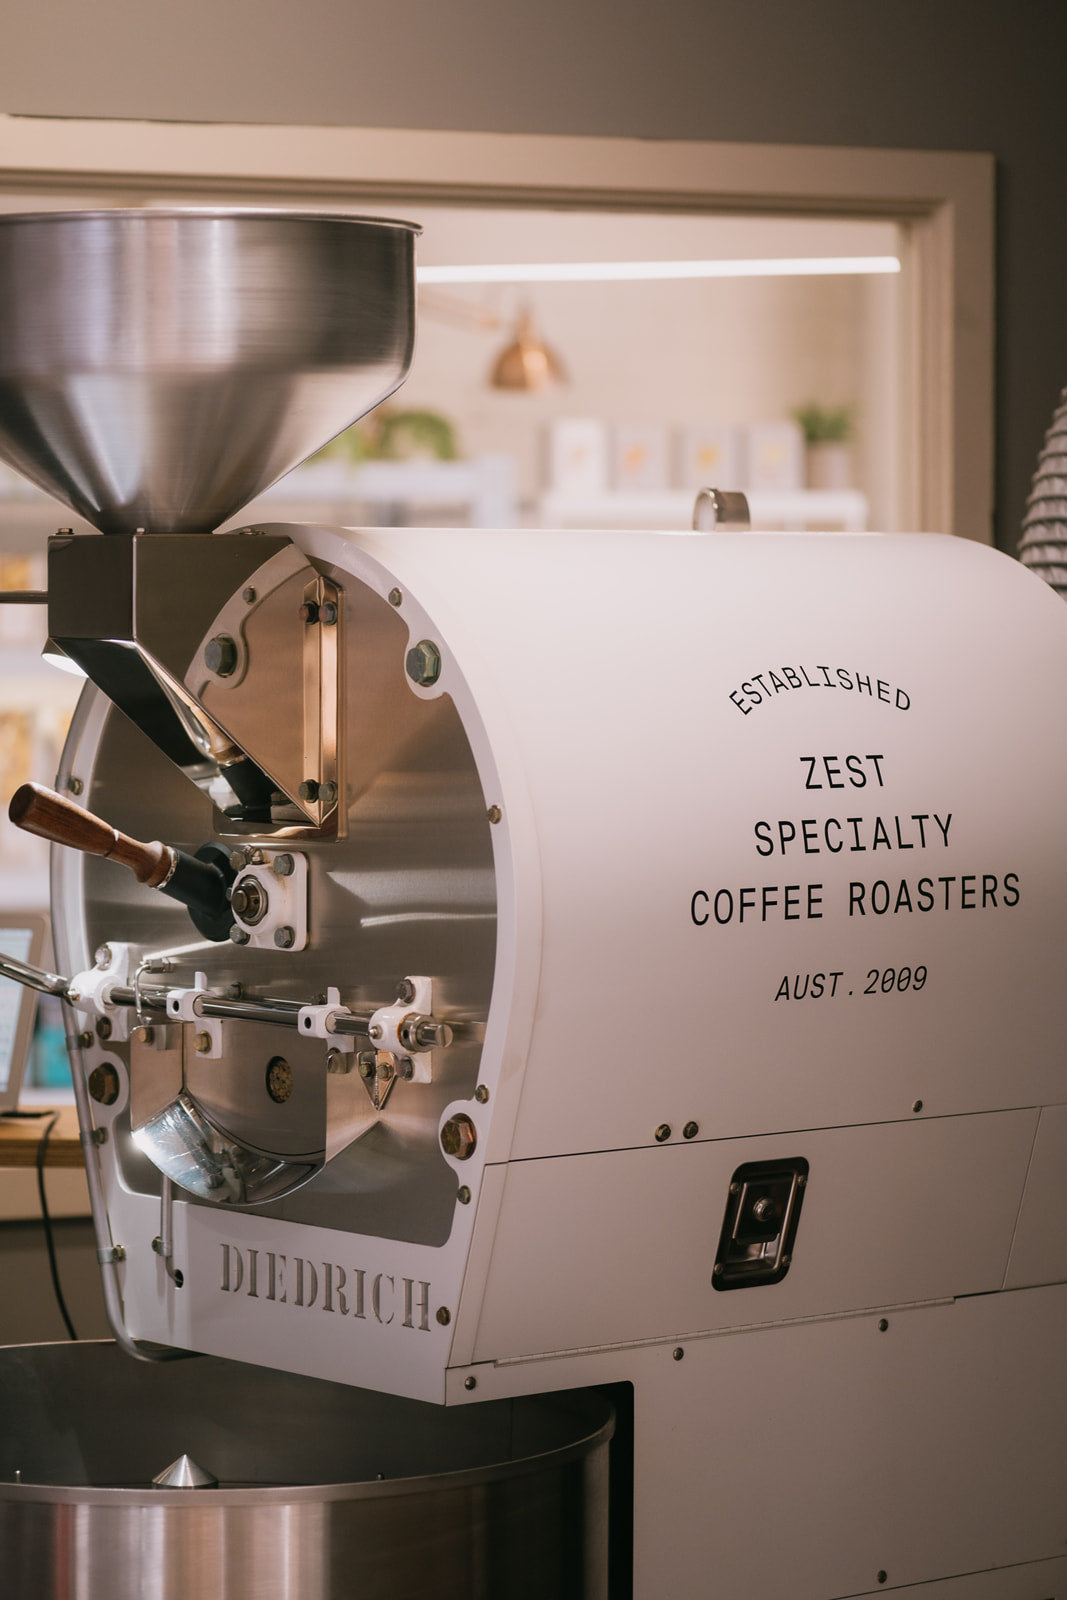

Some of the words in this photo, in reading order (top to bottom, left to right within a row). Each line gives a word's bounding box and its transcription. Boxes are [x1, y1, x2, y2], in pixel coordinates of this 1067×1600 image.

[729, 666, 911, 716] ESTABLISHED
[800, 755, 885, 789] ZEST
[755, 814, 952, 857] SPECIALTY
[691, 884, 823, 927] COFFEE
[849, 873, 1020, 917] ROASTERS
[220, 1243, 431, 1332] DIEDRICH
